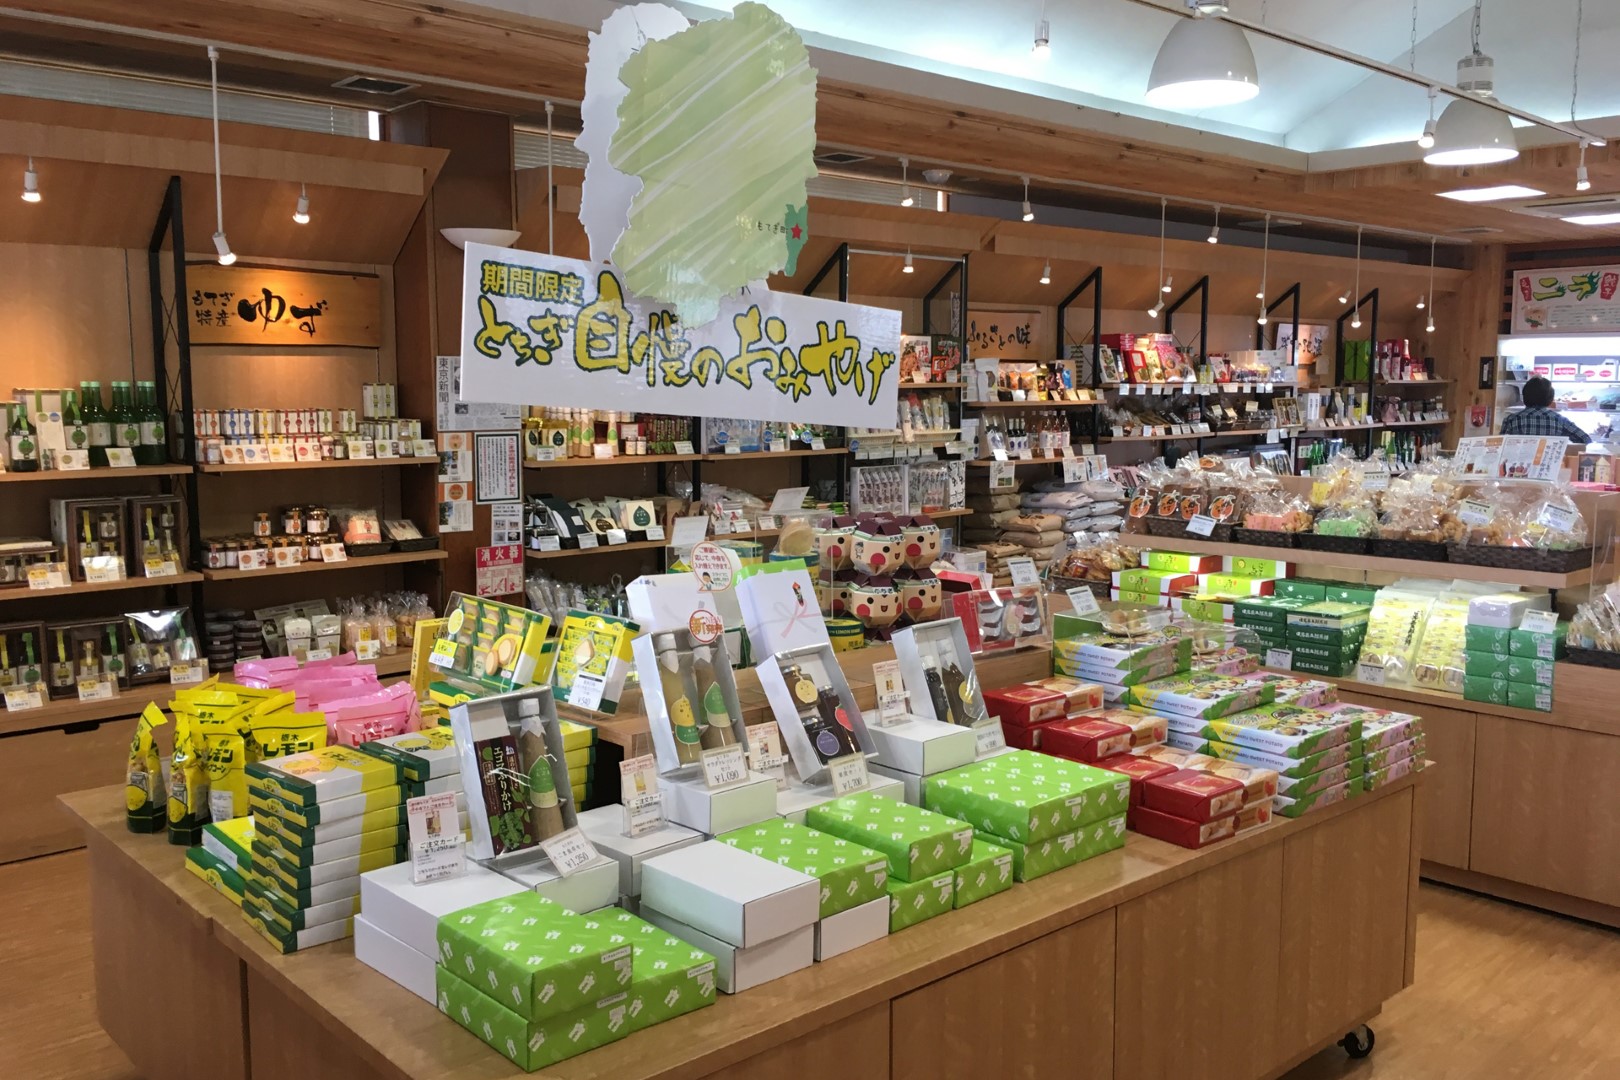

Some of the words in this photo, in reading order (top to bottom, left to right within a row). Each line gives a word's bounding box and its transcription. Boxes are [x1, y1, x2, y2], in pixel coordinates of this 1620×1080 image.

[481, 262, 584, 305] 期間限定
[192, 290, 235, 306] もてぎ
[195, 309, 232, 327] 特産
[237, 288, 328, 338] ゆず
[474, 270, 896, 405] とちぎ自慢のおみやげ
[967, 320, 1031, 350] ふるさとの味
[438, 357, 449, 402] 東京新聞
[481, 546, 518, 561] 消火器
[691, 616, 724, 635] 新発売
[1180, 704, 1197, 712] POTATO
[263, 742, 314, 757] レモン
[1265, 740, 1284, 748] POTATO
[1265, 757, 1284, 767] POTATO
[420, 836, 458, 849] ご注文カード
[565, 851, 589, 868] ¥1,250
